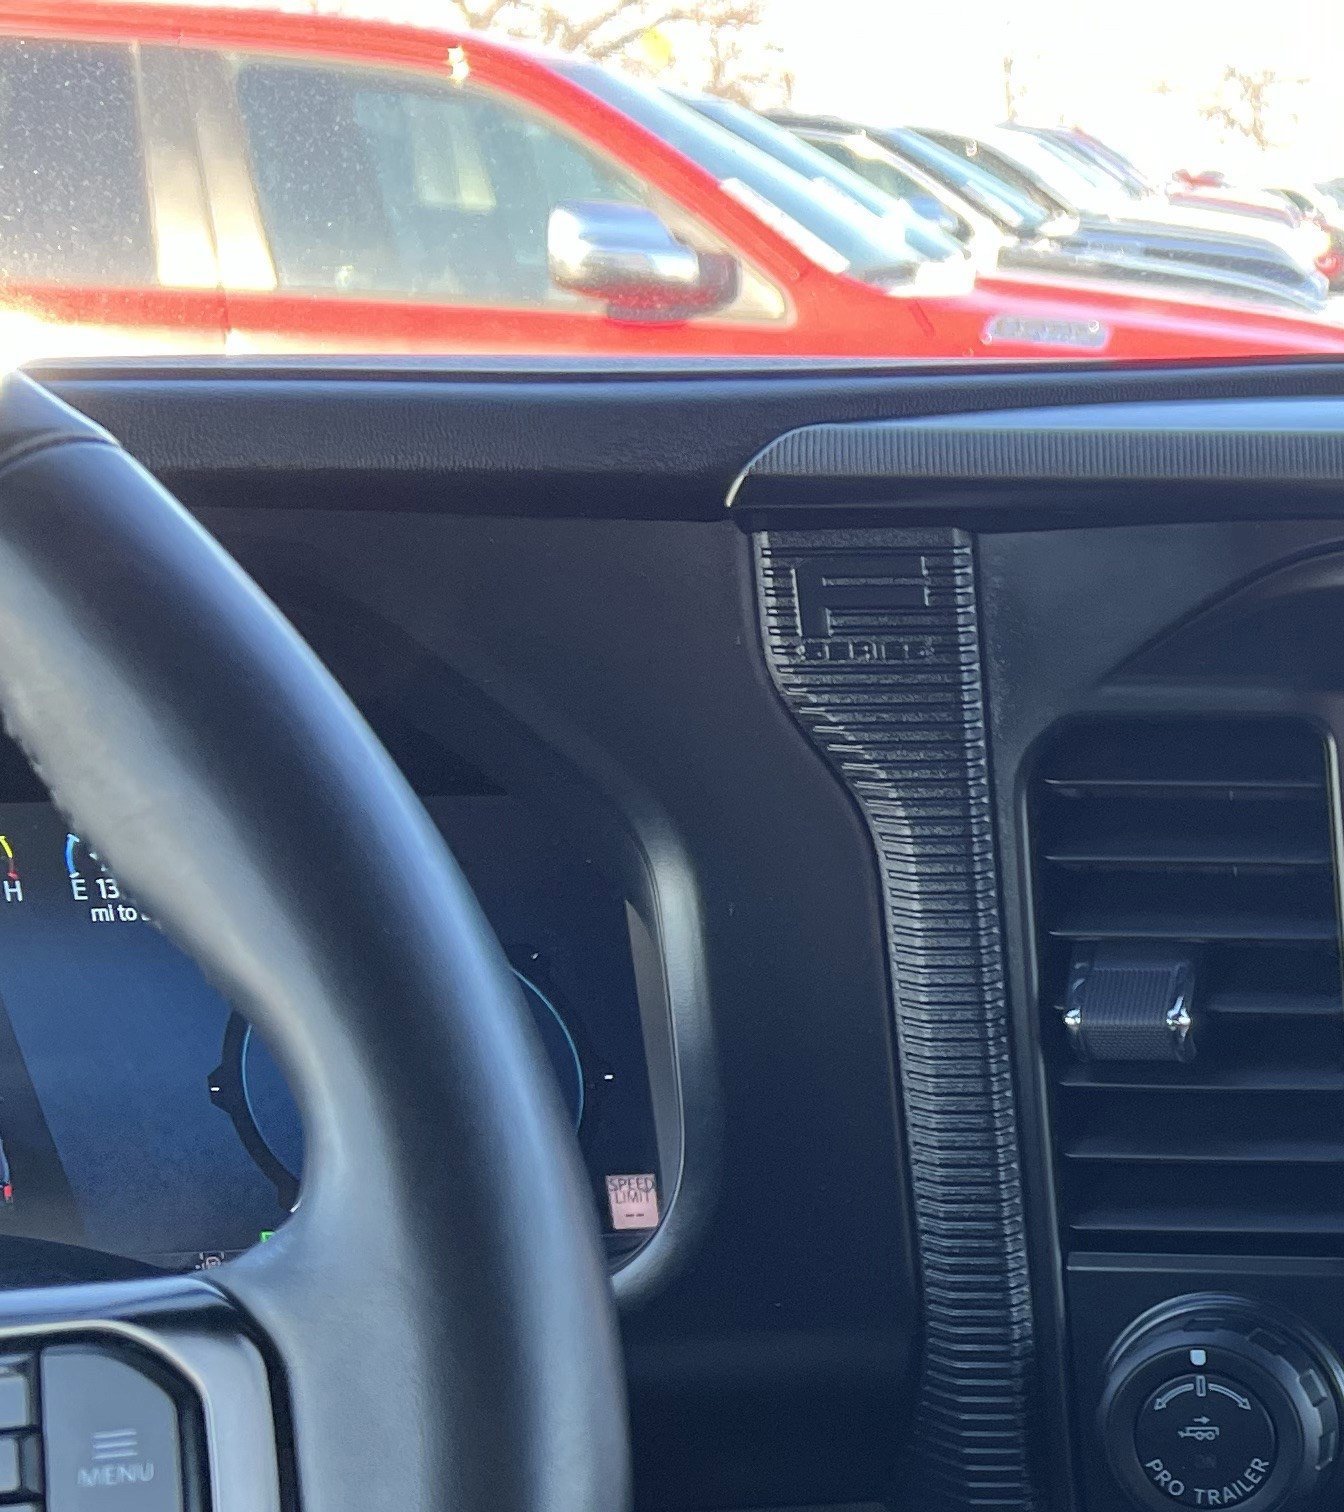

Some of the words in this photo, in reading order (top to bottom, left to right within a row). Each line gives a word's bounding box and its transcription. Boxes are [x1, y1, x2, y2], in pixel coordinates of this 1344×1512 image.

[3, 880, 23, 901] H
[71, 878, 88, 900] E
[91, 904, 114, 921] mi
[117, 904, 138, 921] to
[608, 1177, 653, 1192] SPEED
[615, 1190, 650, 1204] LIMIT
[78, 1461, 154, 1486] MENU
[1145, 1457, 1185, 1497] PRO
[1193, 1457, 1269, 1506] TRAILER
